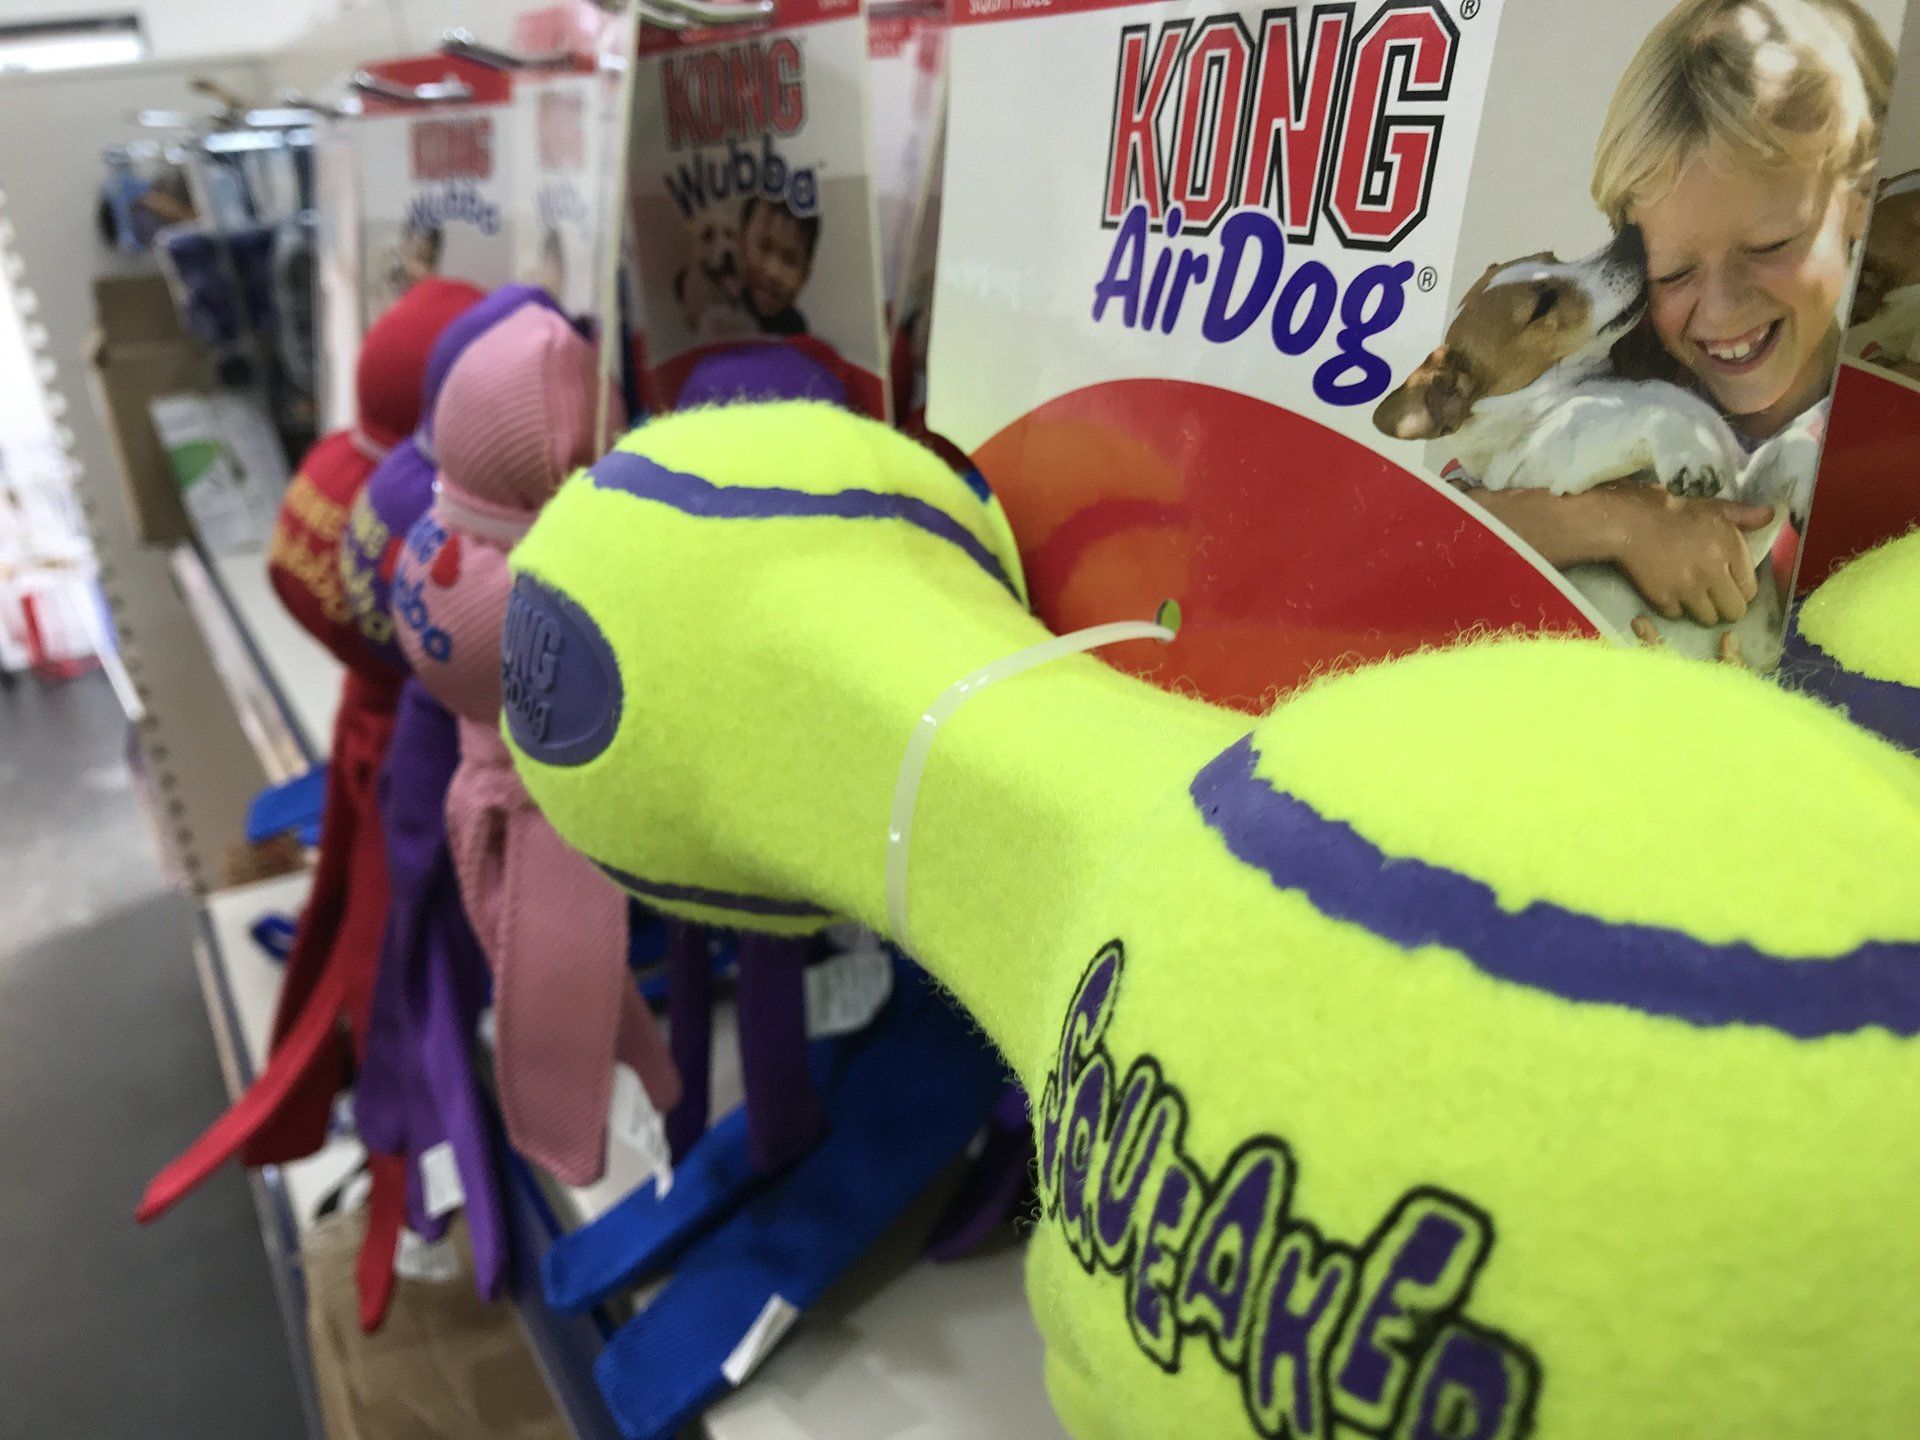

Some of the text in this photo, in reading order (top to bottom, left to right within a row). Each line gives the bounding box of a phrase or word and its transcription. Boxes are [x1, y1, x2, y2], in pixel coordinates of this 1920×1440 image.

[660, 36, 807, 152] KONG
[1101, 0, 1461, 253] KONG
[662, 132, 820, 220] Wubba
[1091, 204, 1416, 407] AirDog
